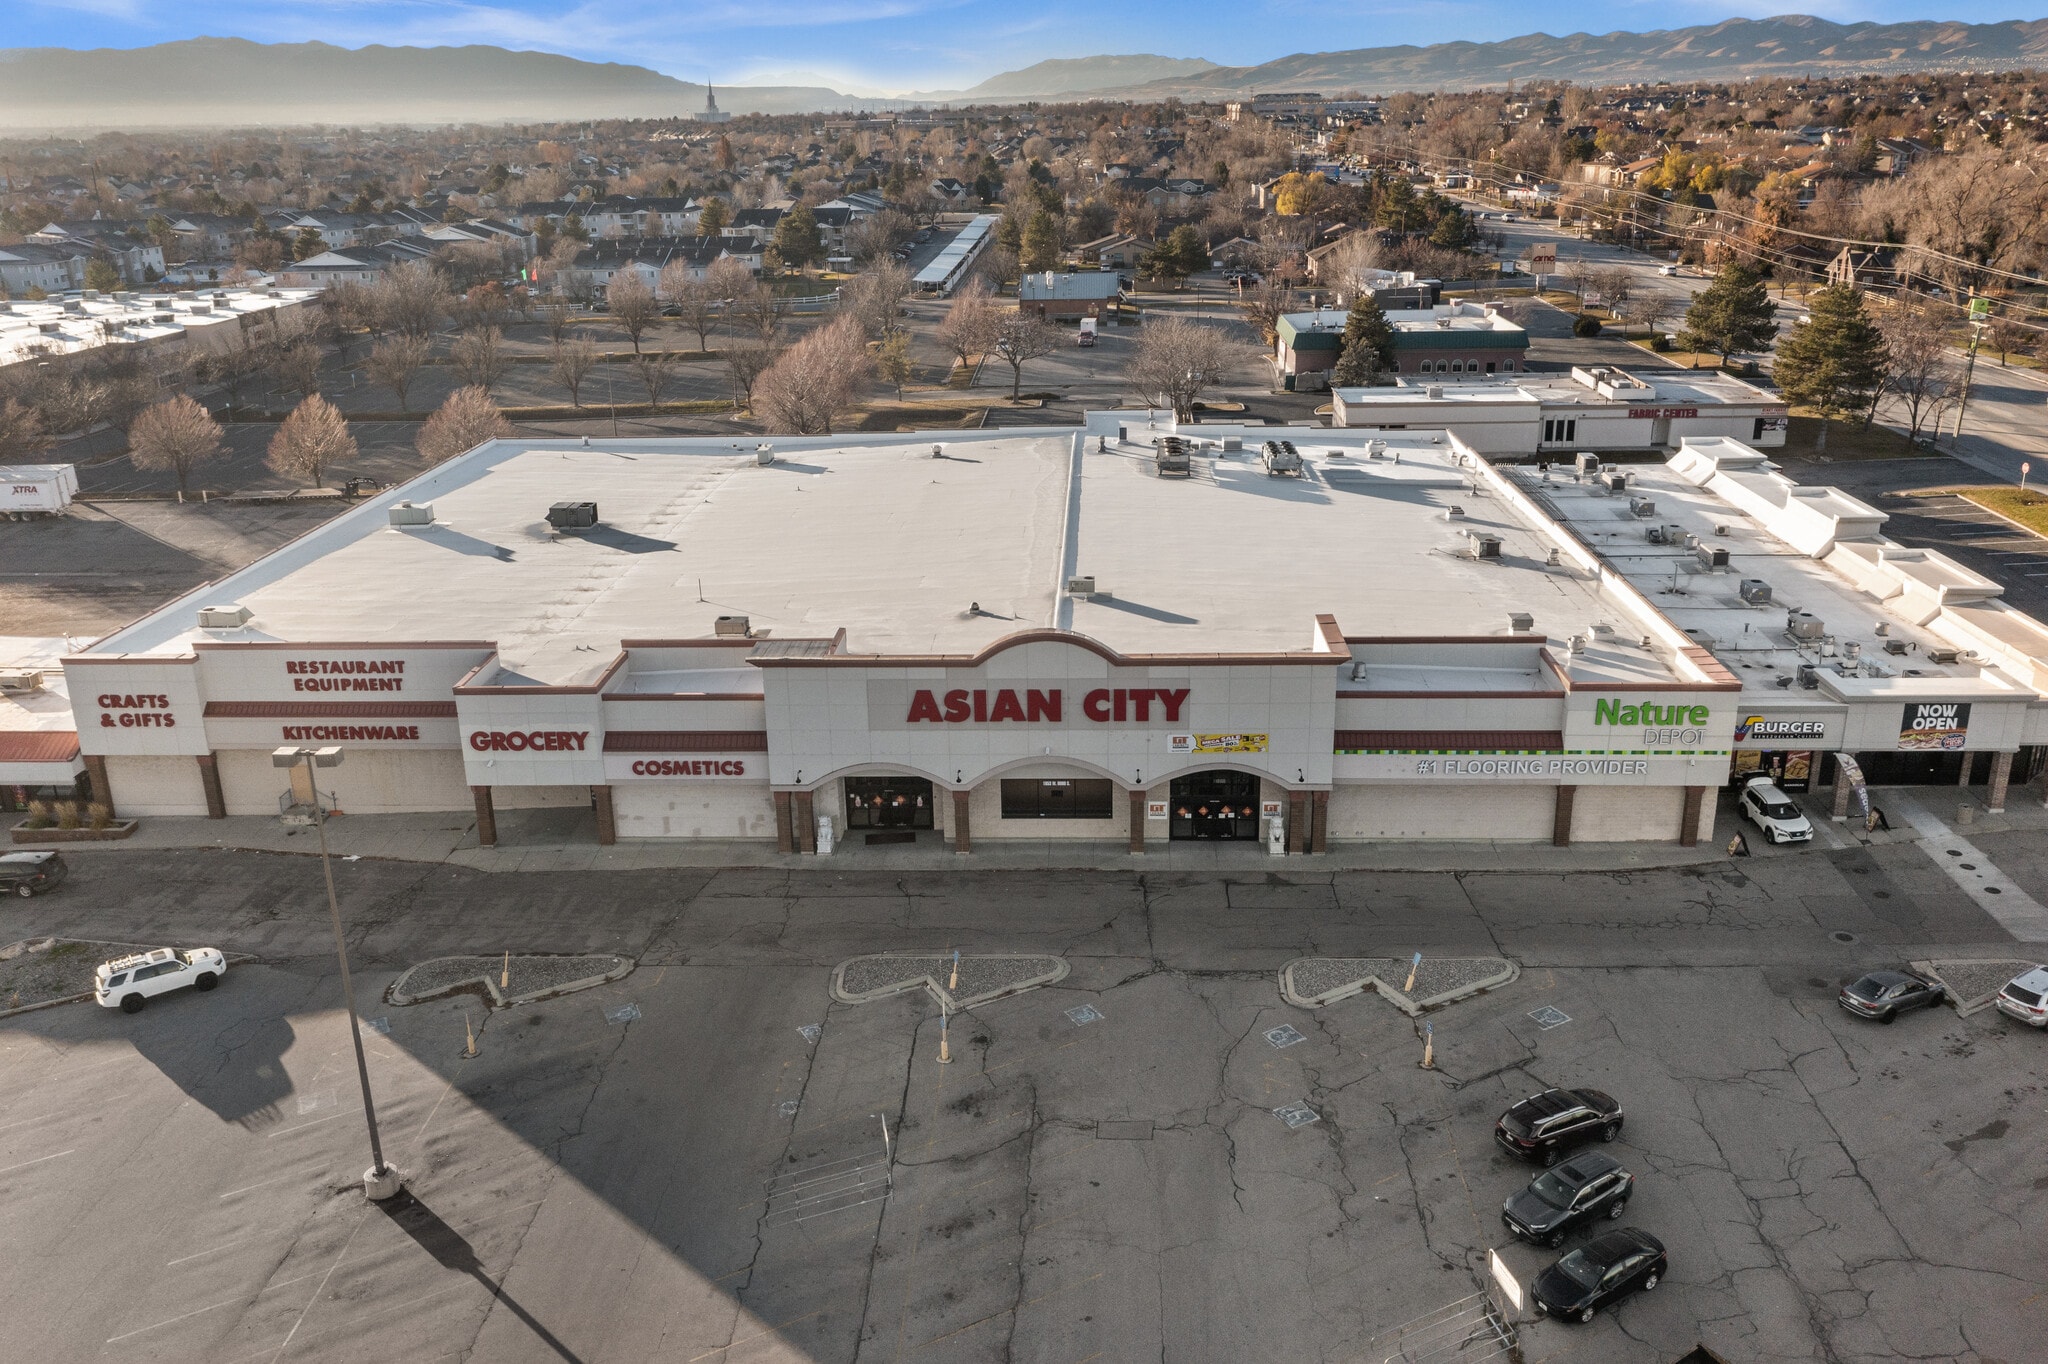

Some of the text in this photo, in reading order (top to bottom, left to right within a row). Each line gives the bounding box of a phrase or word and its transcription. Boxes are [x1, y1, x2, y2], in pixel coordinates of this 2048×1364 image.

[1628, 408, 1698, 419] FABRIC CENTER
[12, 485, 38, 495] XTRA
[286, 660, 405, 675] RESTAURANT
[294, 678, 403, 692] EQUIPMENT
[97, 694, 170, 709] CRAFTS
[906, 688, 1191, 723] ASIAN CITY
[1594, 698, 1710, 727] Nature
[1916, 704, 1959, 718] NOW
[100, 713, 176, 728] & GIFTS
[1753, 721, 1825, 734] BURGER
[1911, 717, 1959, 731] OPEN
[282, 726, 420, 740] KITCHENWARE
[1643, 728, 1708, 746] DEPOT
[470, 731, 590, 751] GROCERY
[632, 760, 744, 776] COSMETICS
[1417, 759, 1649, 775] #1 FLOORING PROVIDER
